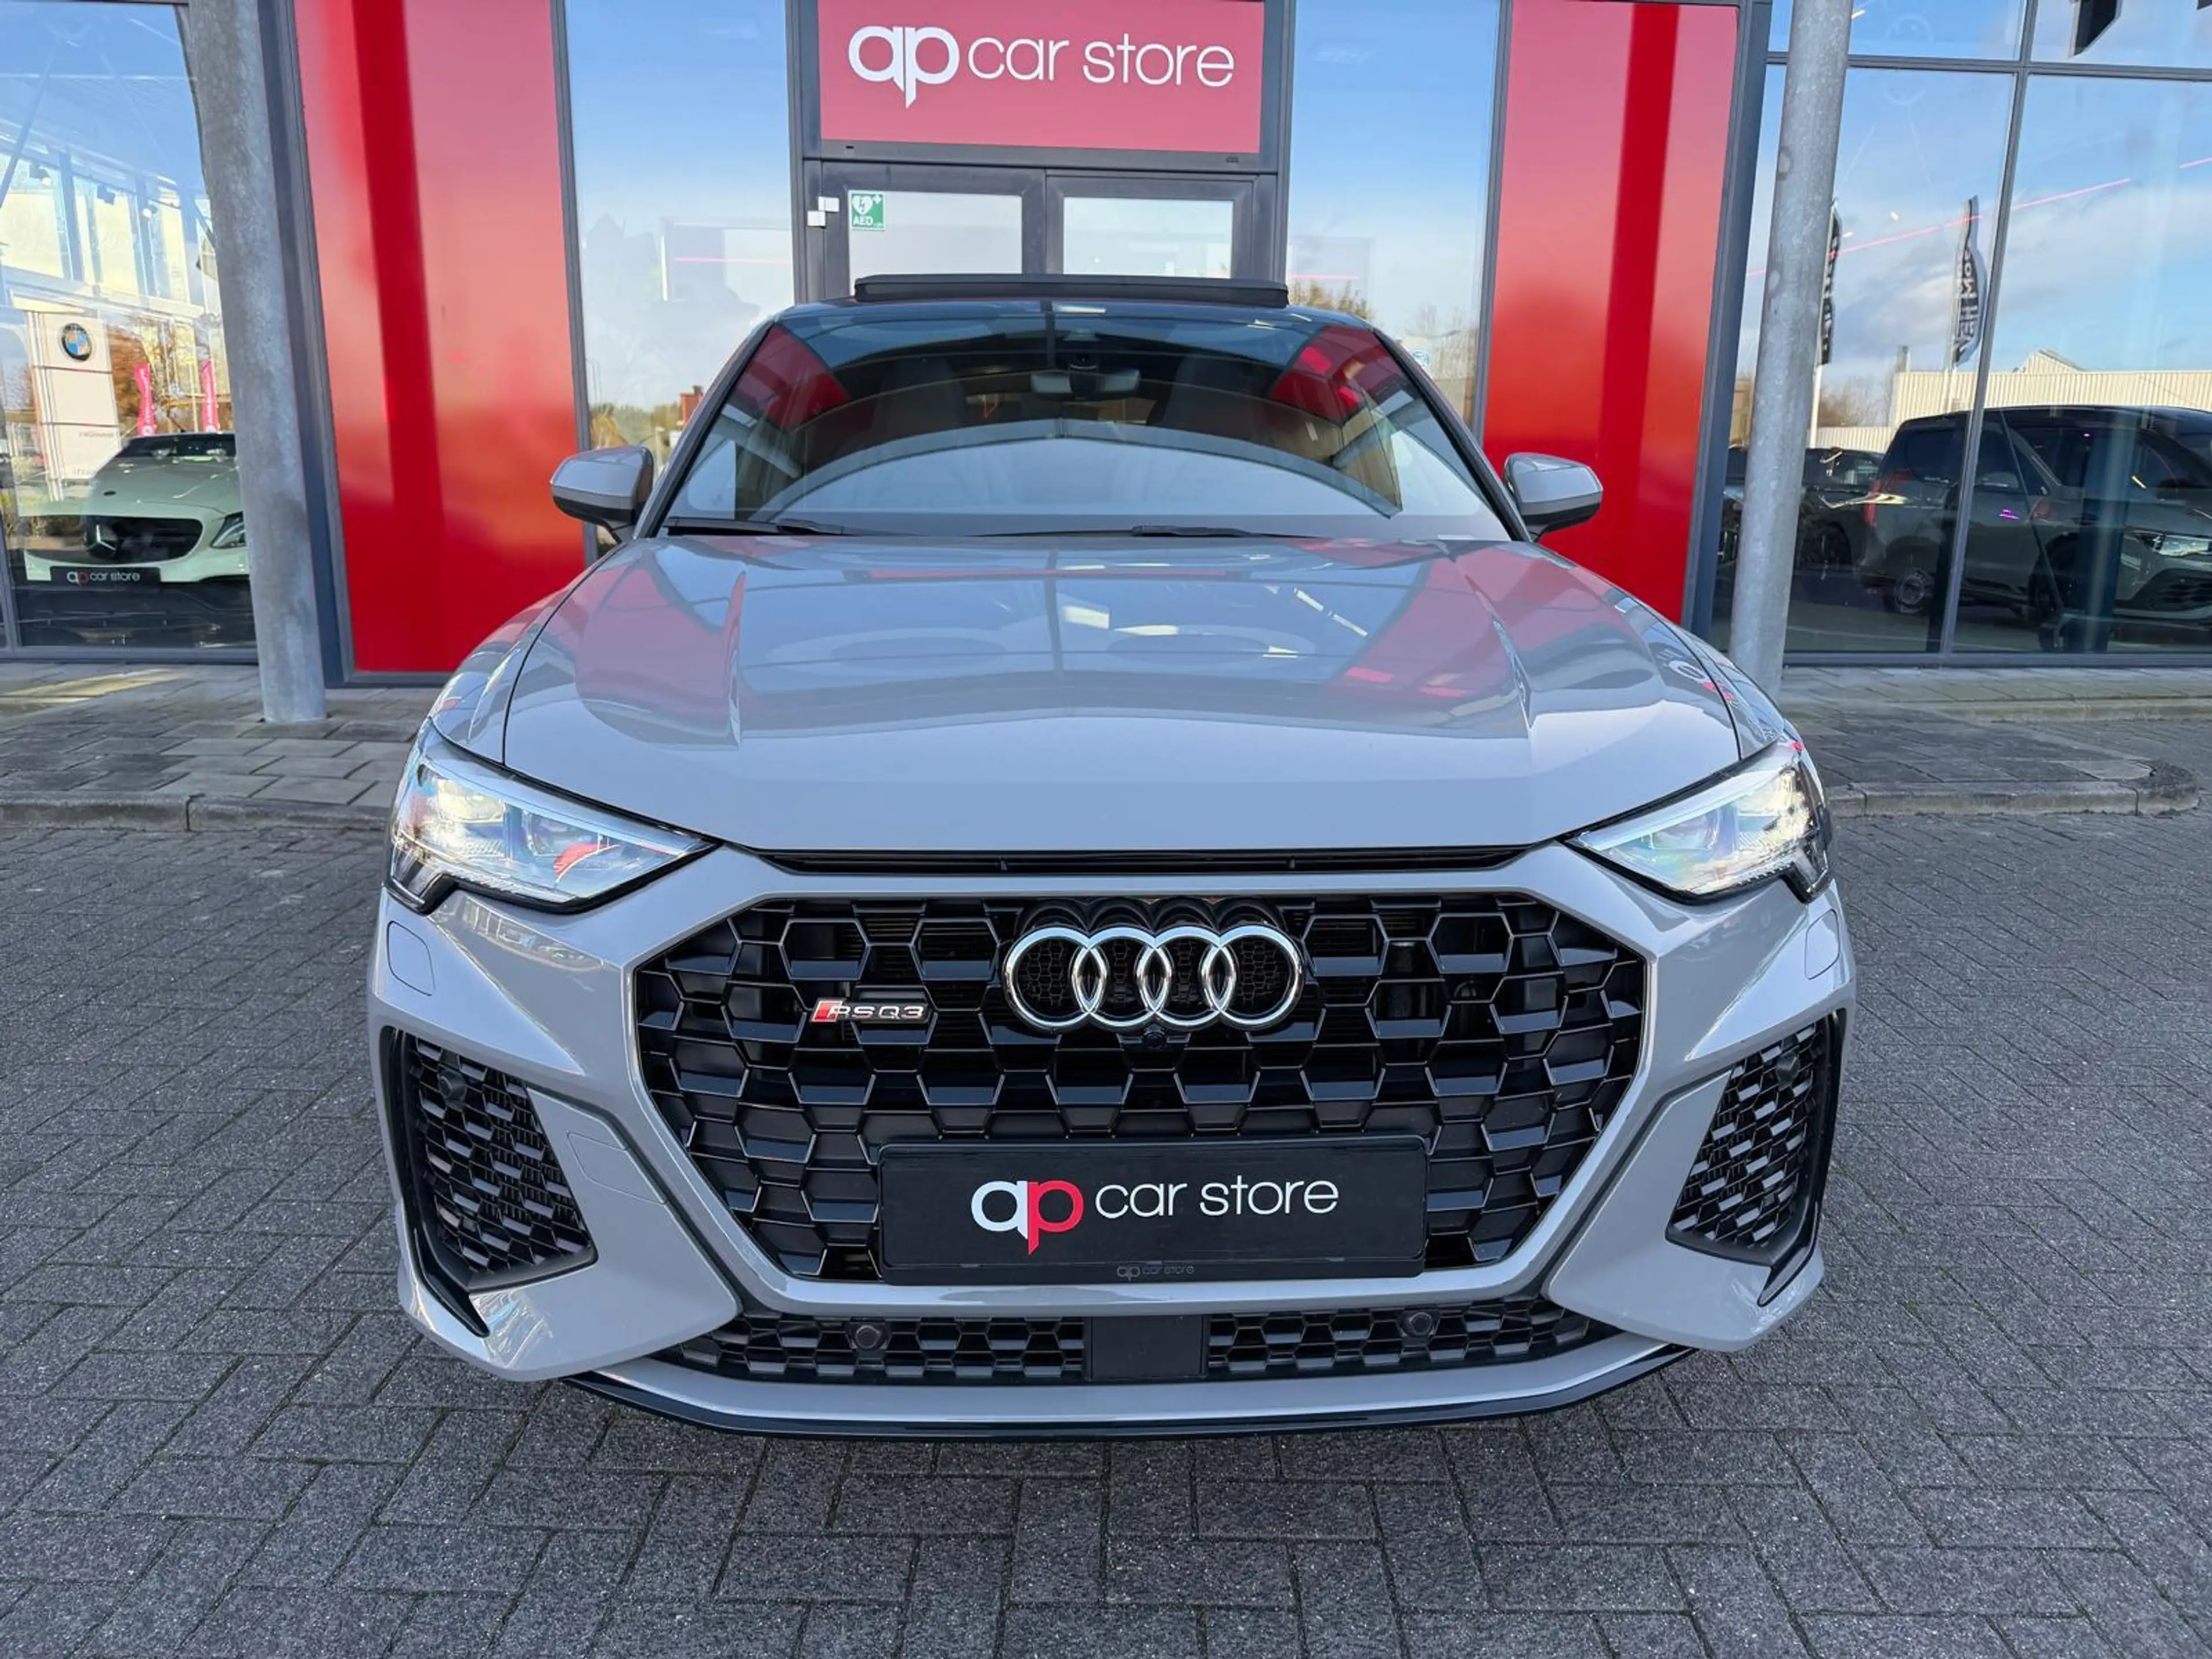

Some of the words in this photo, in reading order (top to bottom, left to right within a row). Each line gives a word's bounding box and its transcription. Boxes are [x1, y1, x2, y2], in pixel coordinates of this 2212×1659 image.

[849, 25, 960, 108] ap
[968, 37, 1070, 81] car
[1083, 33, 1235, 87] store
[853, 215, 873, 226] AED
[90, 573, 108, 582] car
[110, 570, 141, 582] store
[971, 1180, 1084, 1255] ap
[1095, 1183, 1187, 1218] car
[1199, 1175, 1339, 1217] store
